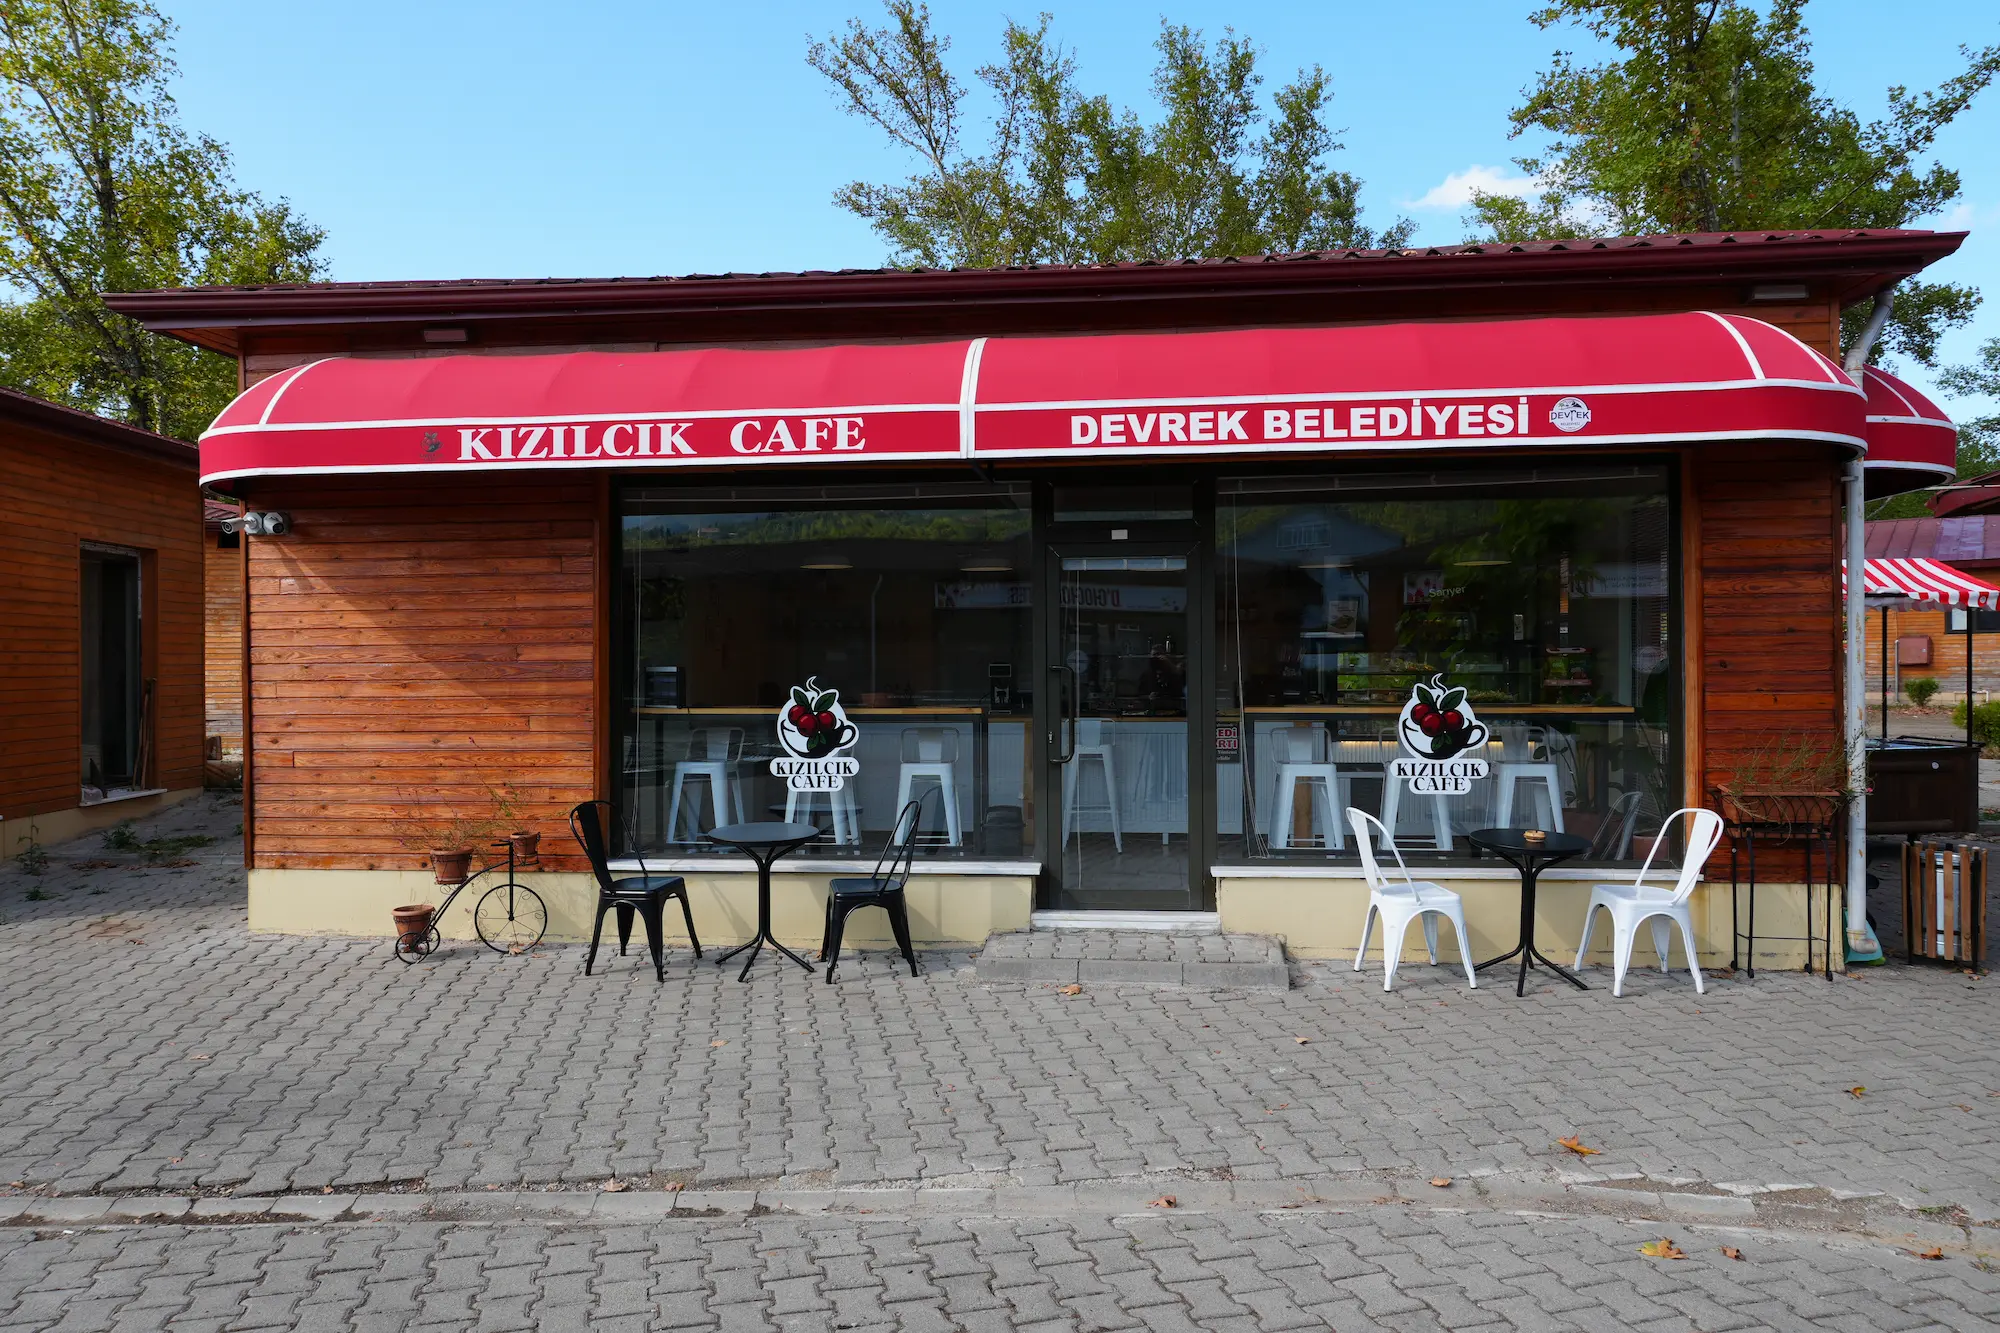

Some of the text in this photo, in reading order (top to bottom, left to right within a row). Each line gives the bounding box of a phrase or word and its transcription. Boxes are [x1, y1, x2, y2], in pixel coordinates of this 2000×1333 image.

[1071, 397, 1529, 444] DEVREK BELEDİYESİ
[456, 417, 866, 461] KIZILCIK CAFE
[776, 762, 853, 774] KIZILCIK
[1397, 763, 1481, 777] KIZILCIK
[792, 775, 838, 788] CAFE
[1414, 777, 1465, 791] CAFE
